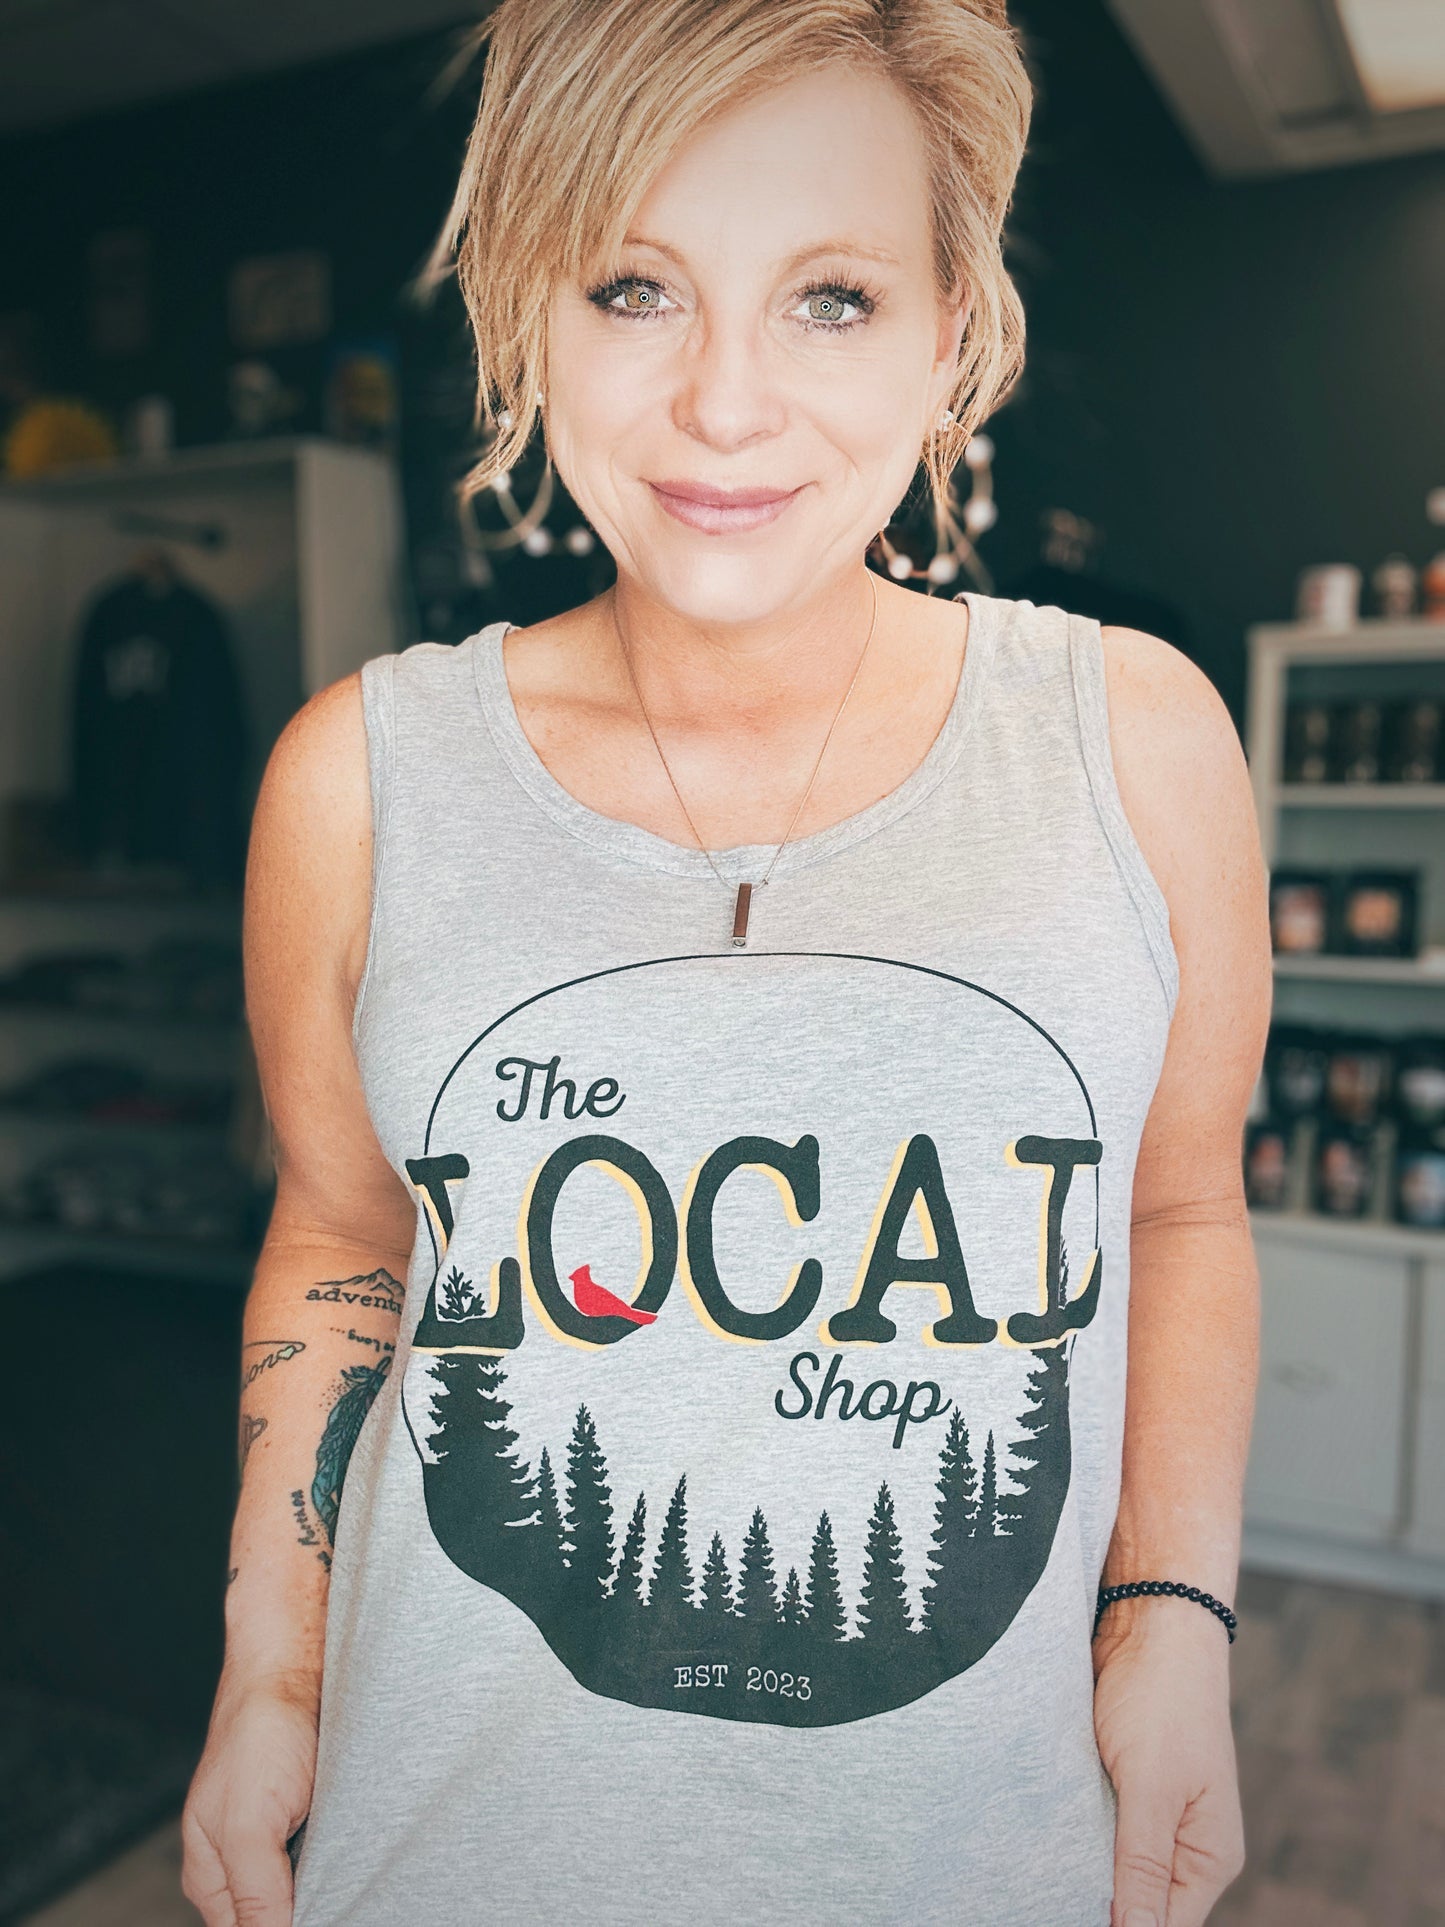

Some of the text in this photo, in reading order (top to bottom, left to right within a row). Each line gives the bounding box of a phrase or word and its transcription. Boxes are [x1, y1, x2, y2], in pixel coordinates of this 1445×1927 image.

[495, 1055, 626, 1122] The
[405, 1133, 1103, 1351] LOCAL
[774, 1351, 952, 1449] Shop
[673, 1664, 812, 1701] EST 2023
